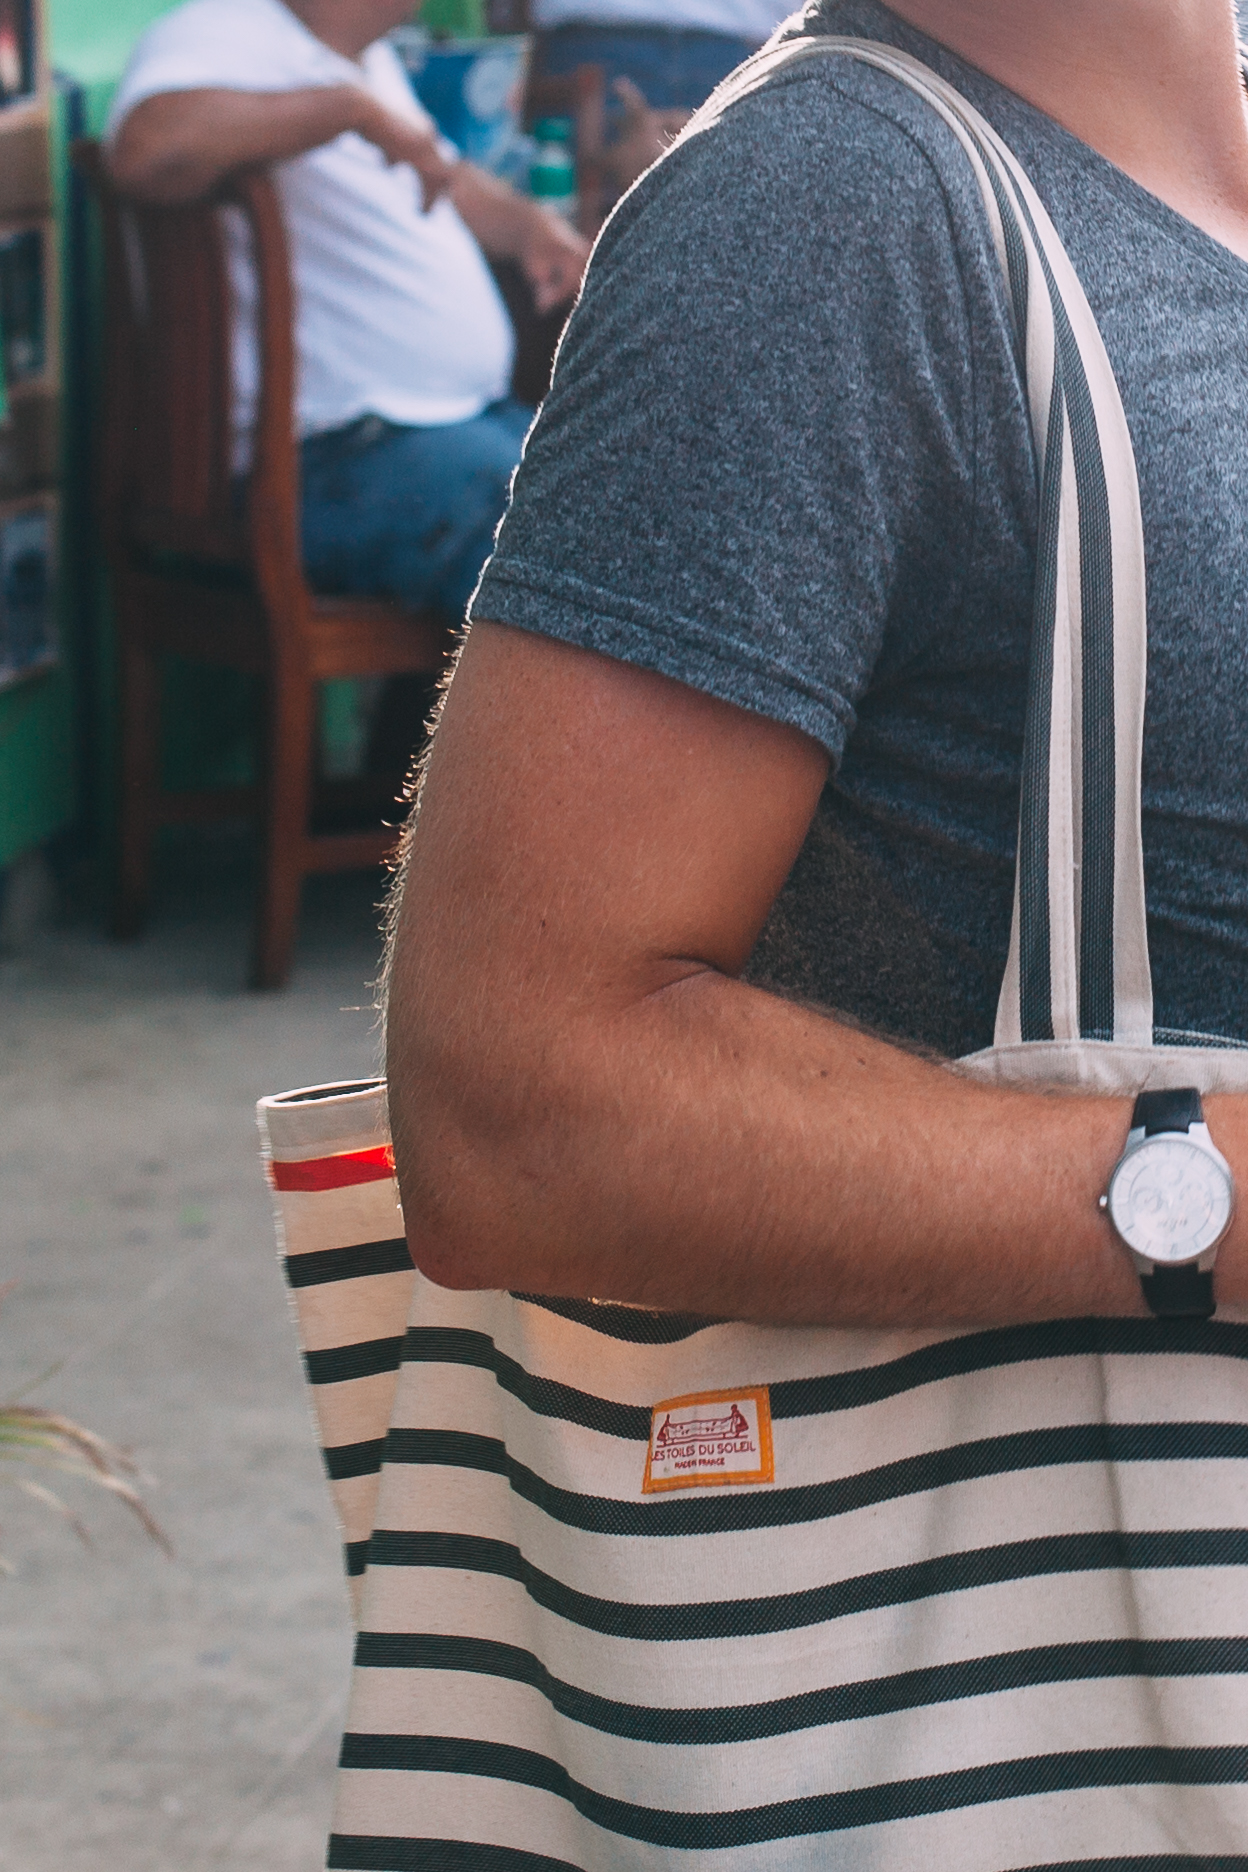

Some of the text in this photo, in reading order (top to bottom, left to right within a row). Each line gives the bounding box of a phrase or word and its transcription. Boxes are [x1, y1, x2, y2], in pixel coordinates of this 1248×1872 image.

[667, 1445, 695, 1458] TOILES
[699, 1444, 714, 1455] DU
[717, 1441, 756, 1454] SOLEIL
